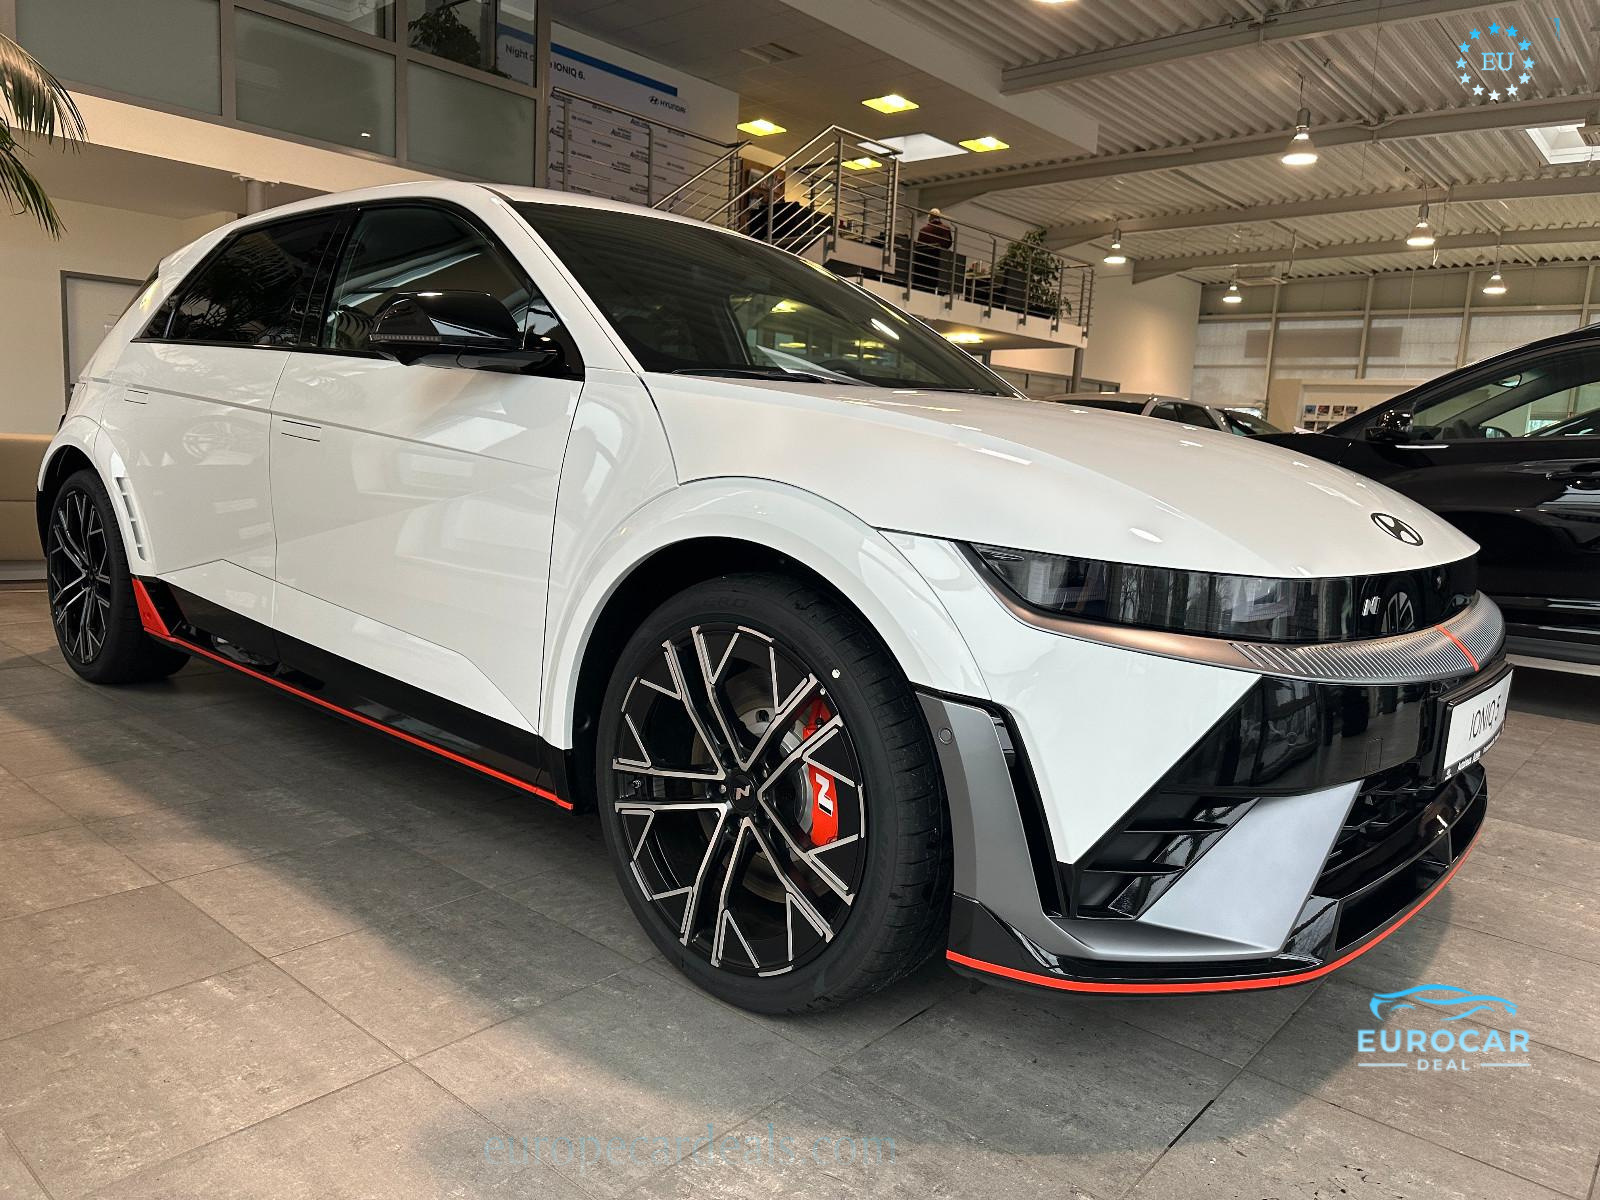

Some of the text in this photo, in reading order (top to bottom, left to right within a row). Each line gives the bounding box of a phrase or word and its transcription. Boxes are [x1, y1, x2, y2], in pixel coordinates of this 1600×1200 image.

[505, 44, 528, 60] Night
[553, 62, 577, 79] IONIQ
[1362, 596, 1380, 616] N
[816, 772, 833, 817] N
